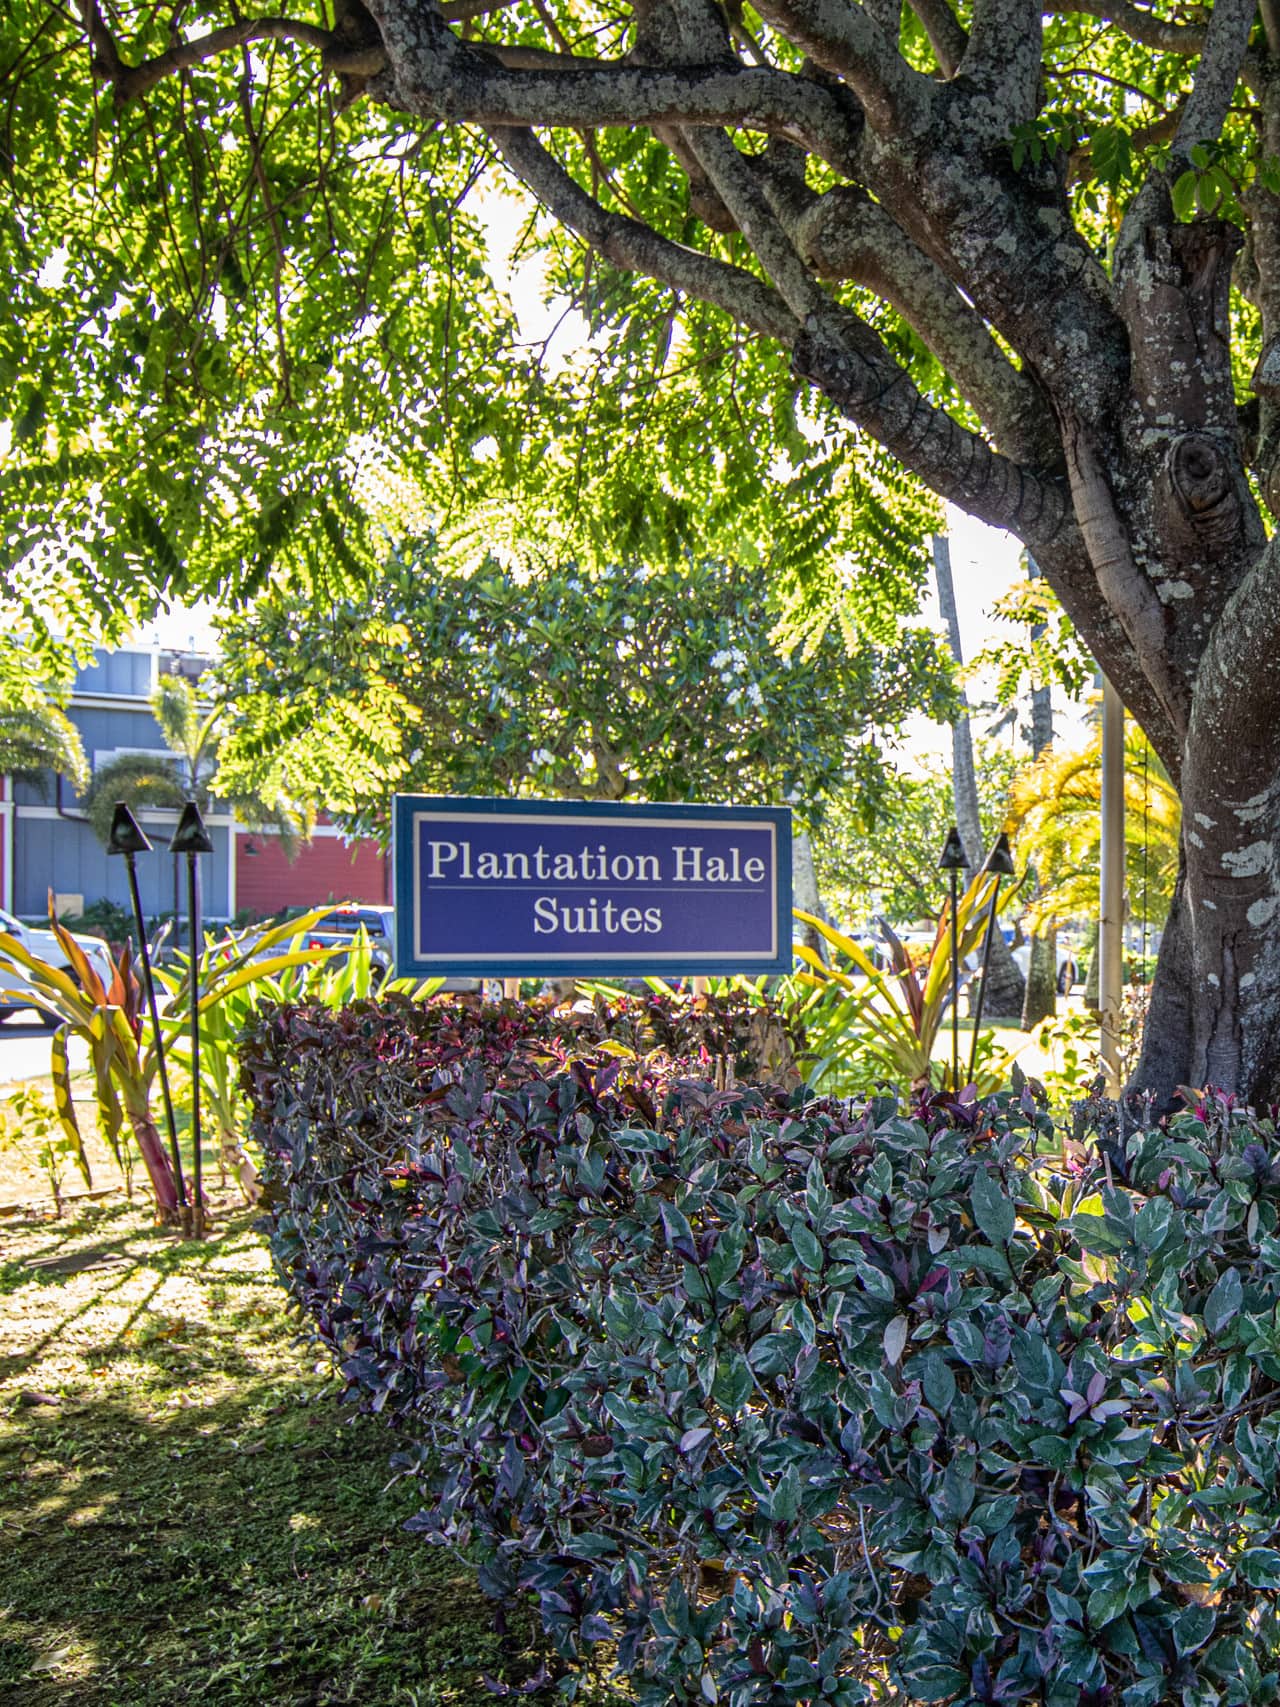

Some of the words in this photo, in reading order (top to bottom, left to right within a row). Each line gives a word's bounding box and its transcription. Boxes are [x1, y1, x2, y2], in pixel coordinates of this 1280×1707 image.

[428, 841, 662, 881] Plantation
[671, 846, 765, 883] Hale
[533, 896, 663, 934] Suites
